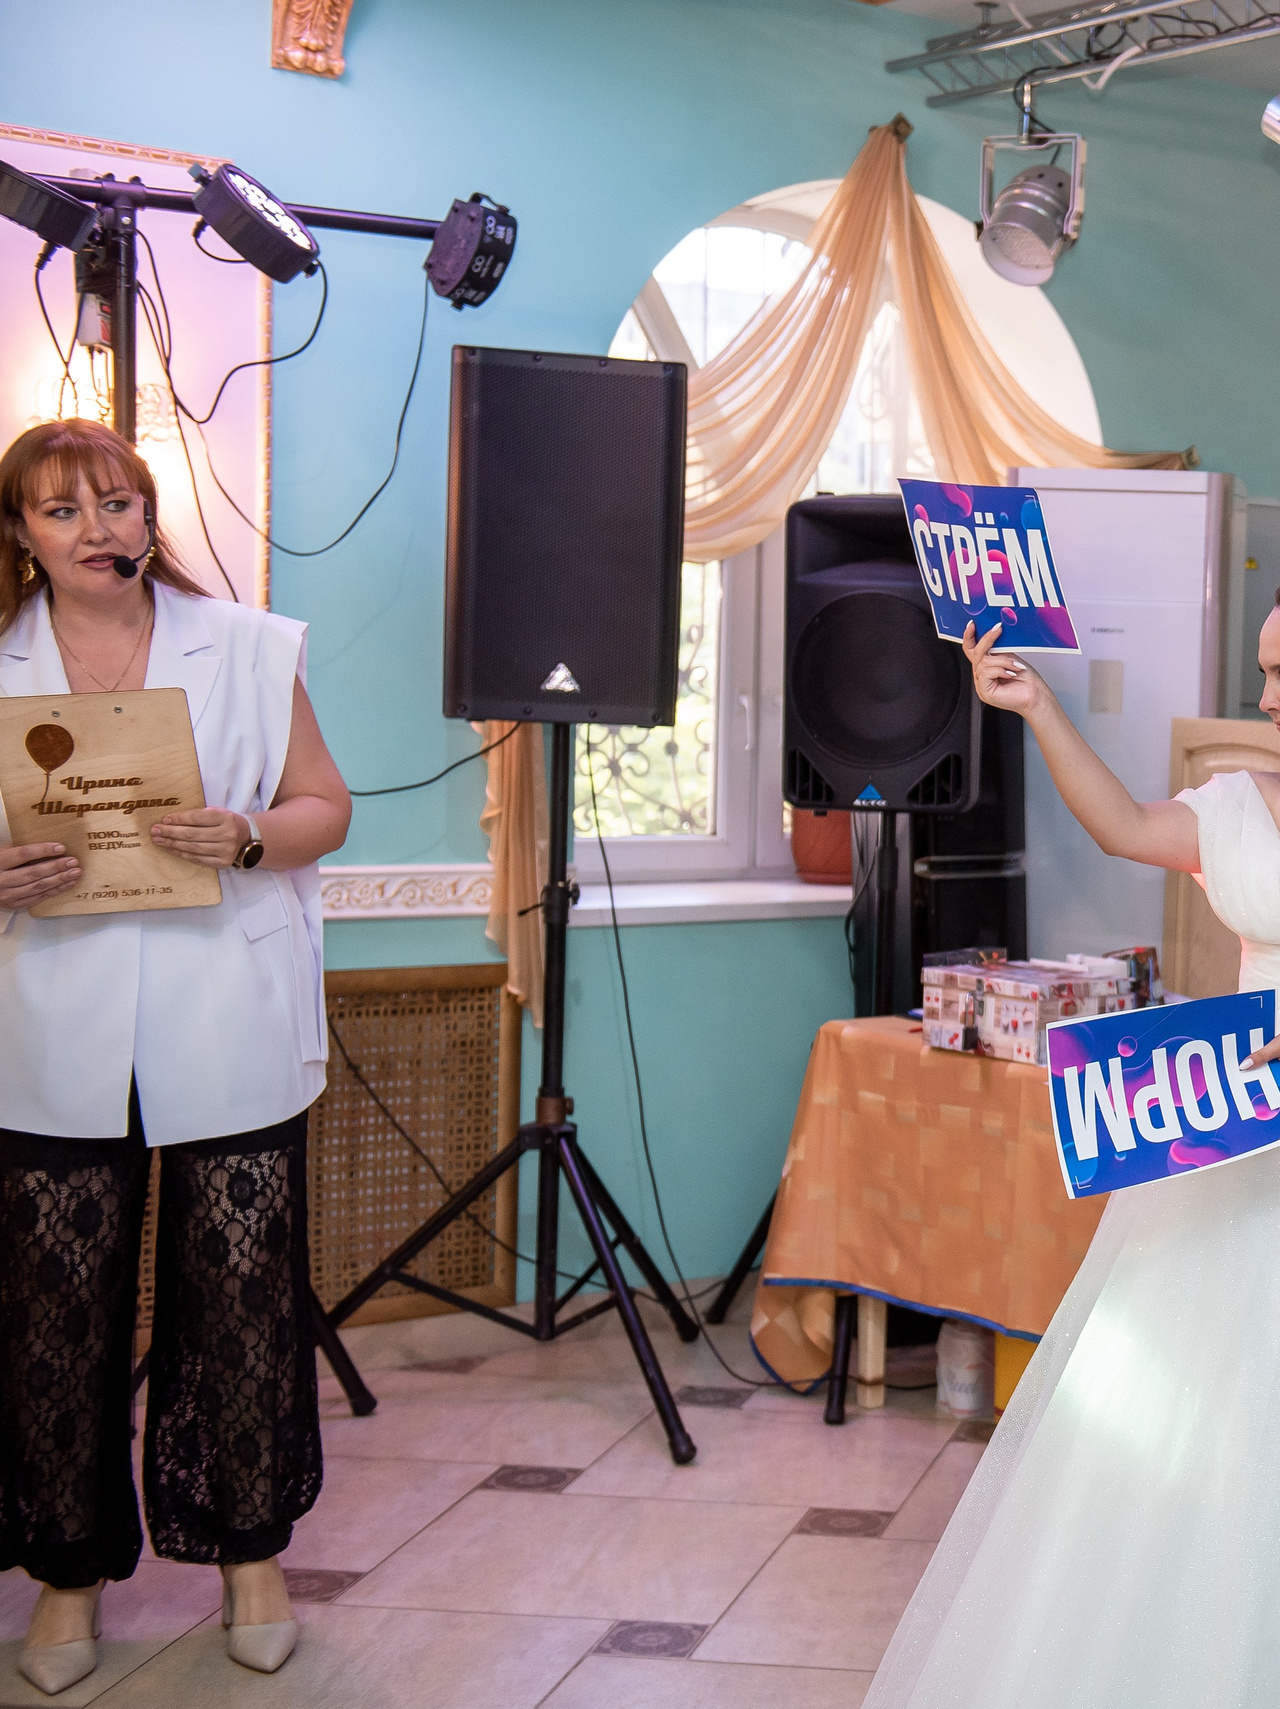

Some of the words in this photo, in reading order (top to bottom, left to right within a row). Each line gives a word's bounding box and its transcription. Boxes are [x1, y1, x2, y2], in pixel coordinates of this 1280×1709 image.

[913, 512, 1060, 608] СТРЁМ
[60, 776, 143, 794] Ирина
[32, 797, 181, 817] Шарандина
[92, 890, 118, 900] (920)
[121, 886, 173, 897] 536-11-35
